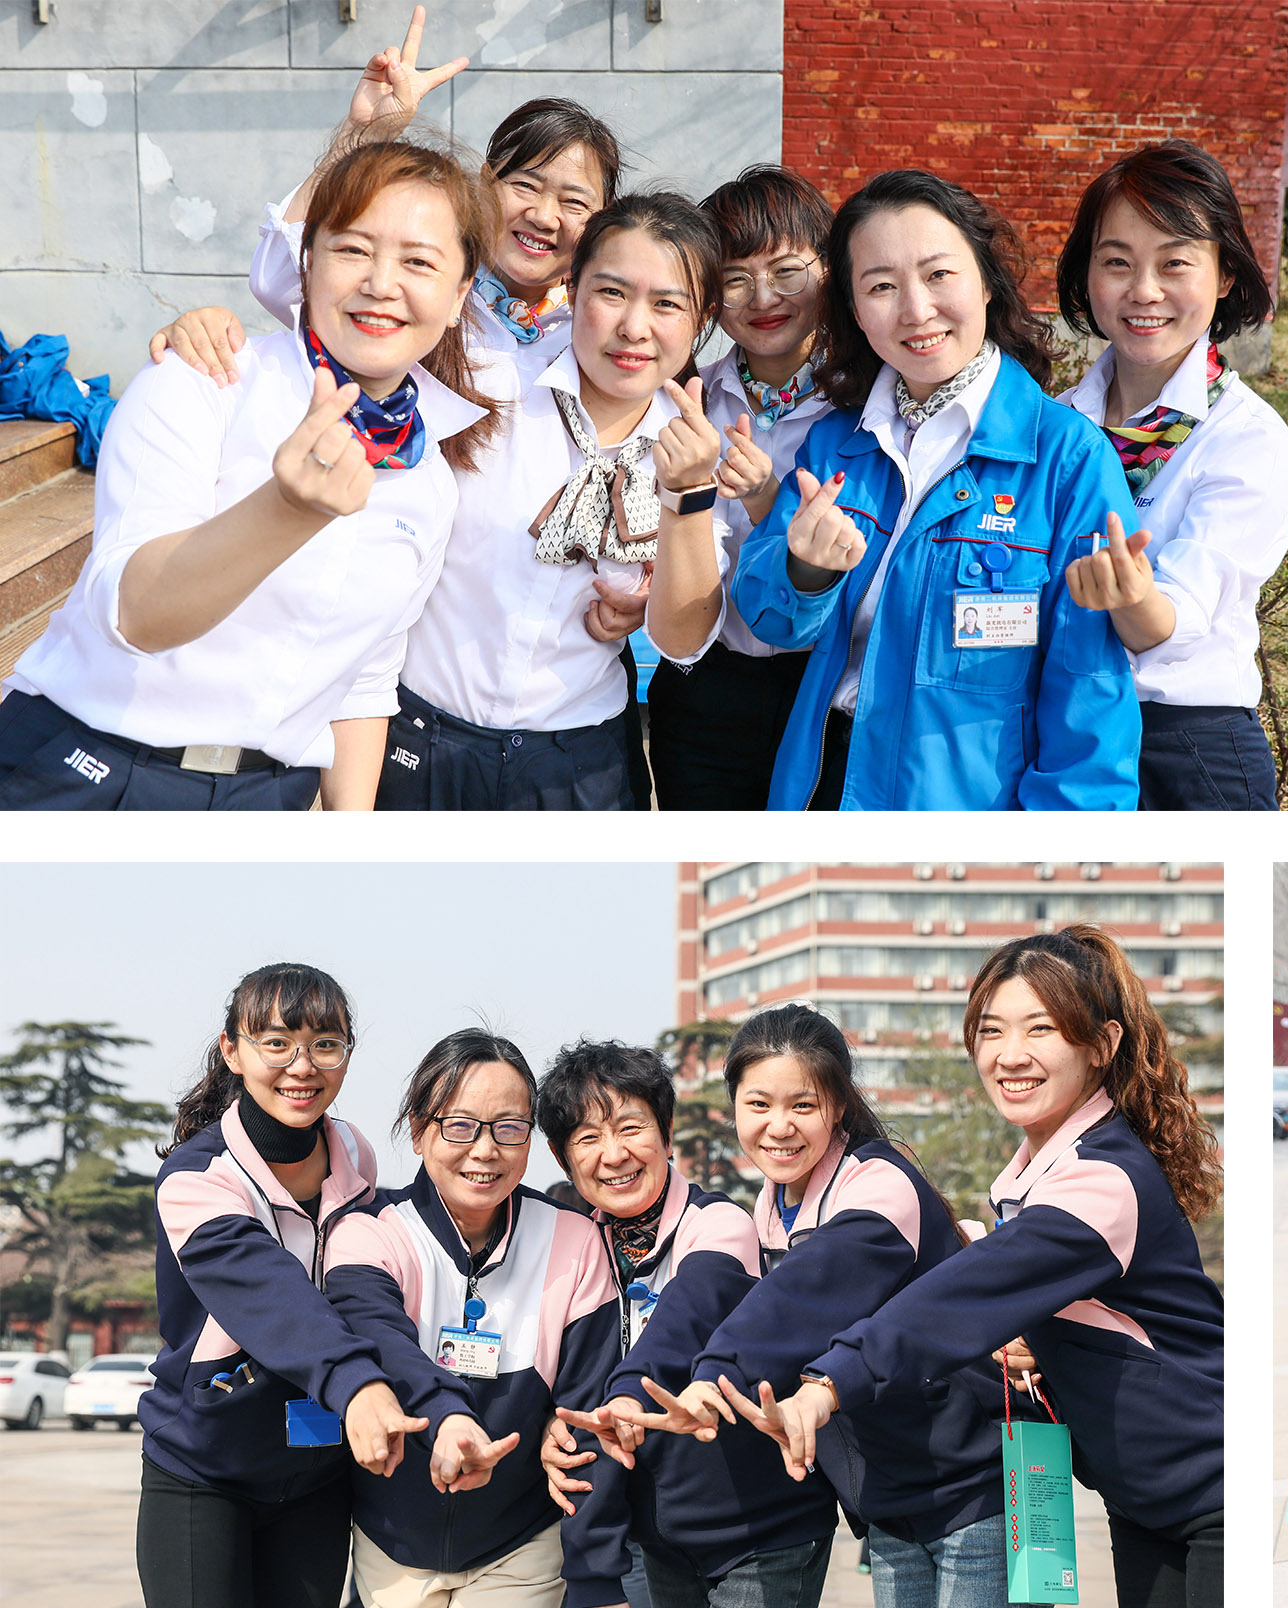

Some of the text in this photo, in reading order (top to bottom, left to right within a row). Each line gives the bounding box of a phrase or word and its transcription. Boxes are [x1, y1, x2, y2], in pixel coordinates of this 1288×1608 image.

[977, 513, 1016, 532] JIER
[64, 748, 110, 784] JIER
[390, 747, 420, 770] JIER
